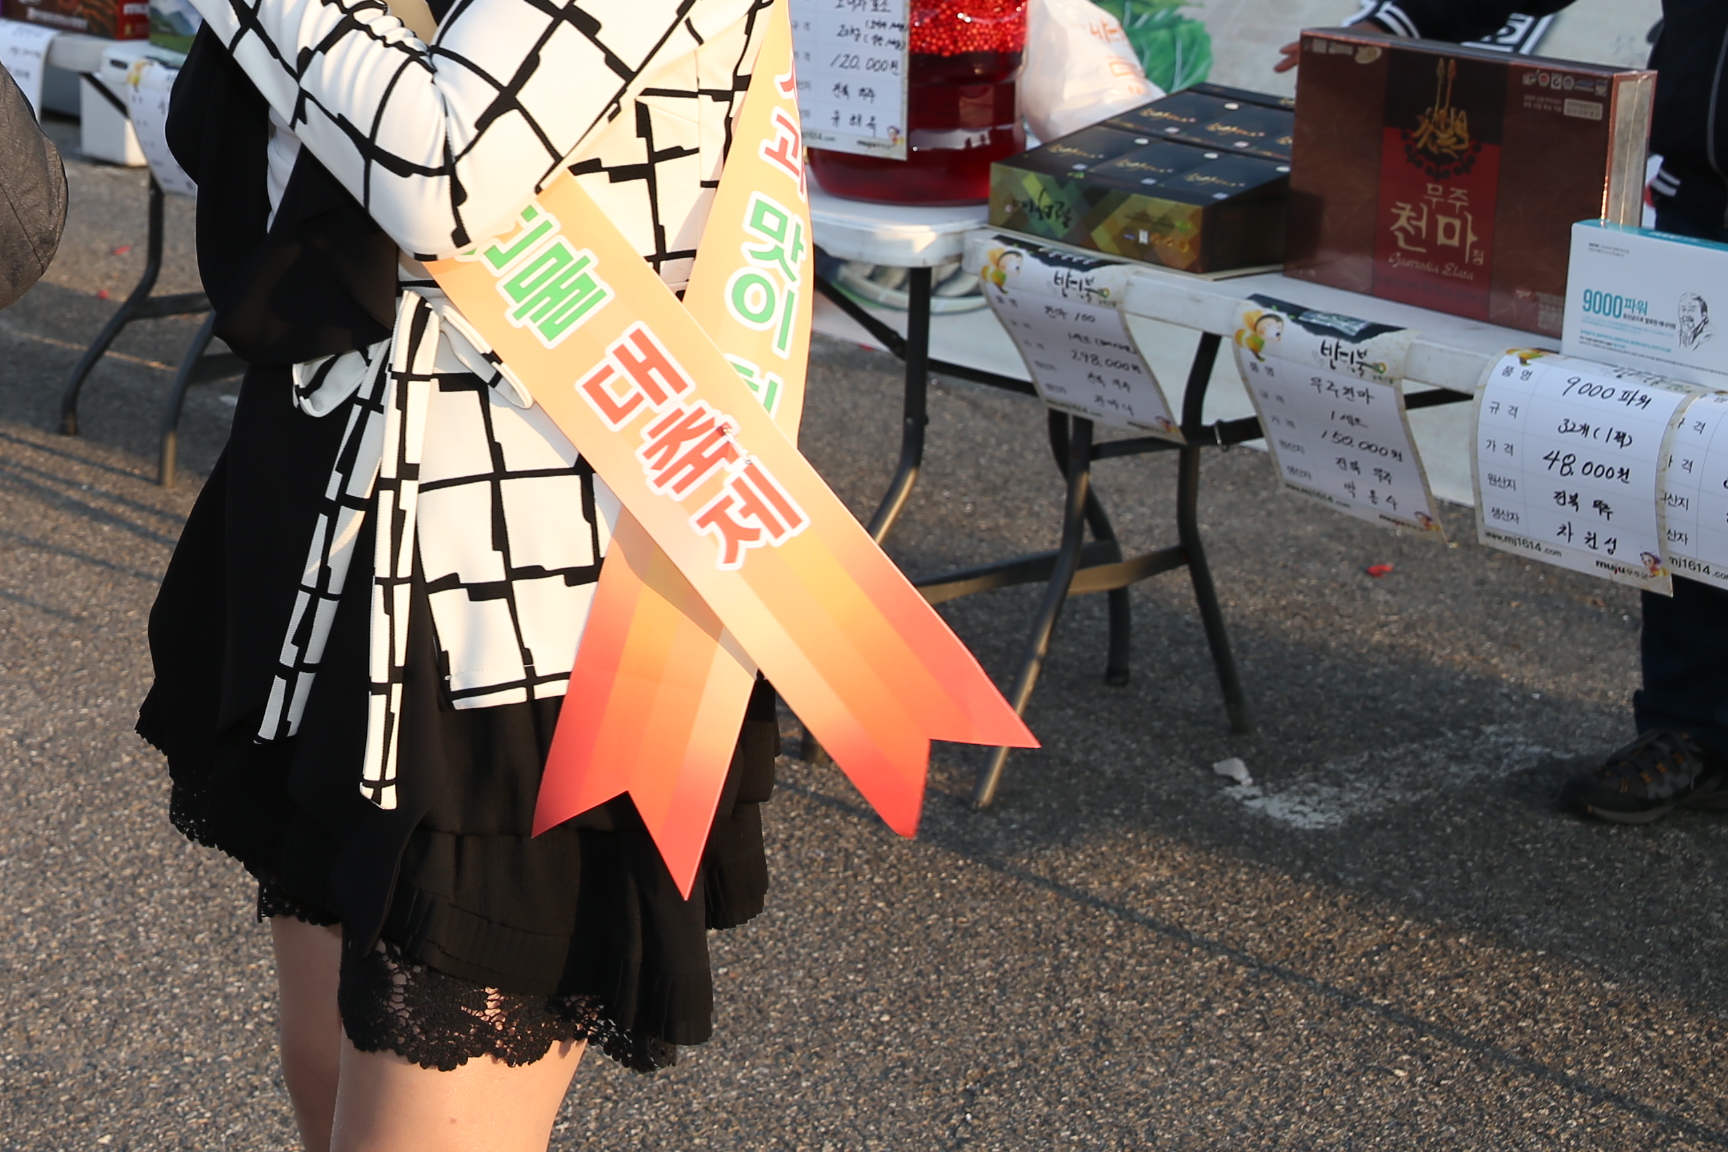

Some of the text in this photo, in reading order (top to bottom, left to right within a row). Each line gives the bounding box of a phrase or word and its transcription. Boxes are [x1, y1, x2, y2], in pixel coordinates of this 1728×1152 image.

[1424, 182, 1470, 215] 무주
[1389, 201, 1478, 265] 천마
[1583, 289, 1623, 319] 9000
[1624, 297, 1649, 316] 파워
[1562, 377, 1615, 401] 9000
[580, 326, 804, 566] 대축제
[1487, 472, 1517, 491] 원산지
[1491, 507, 1520, 525] 생산자
